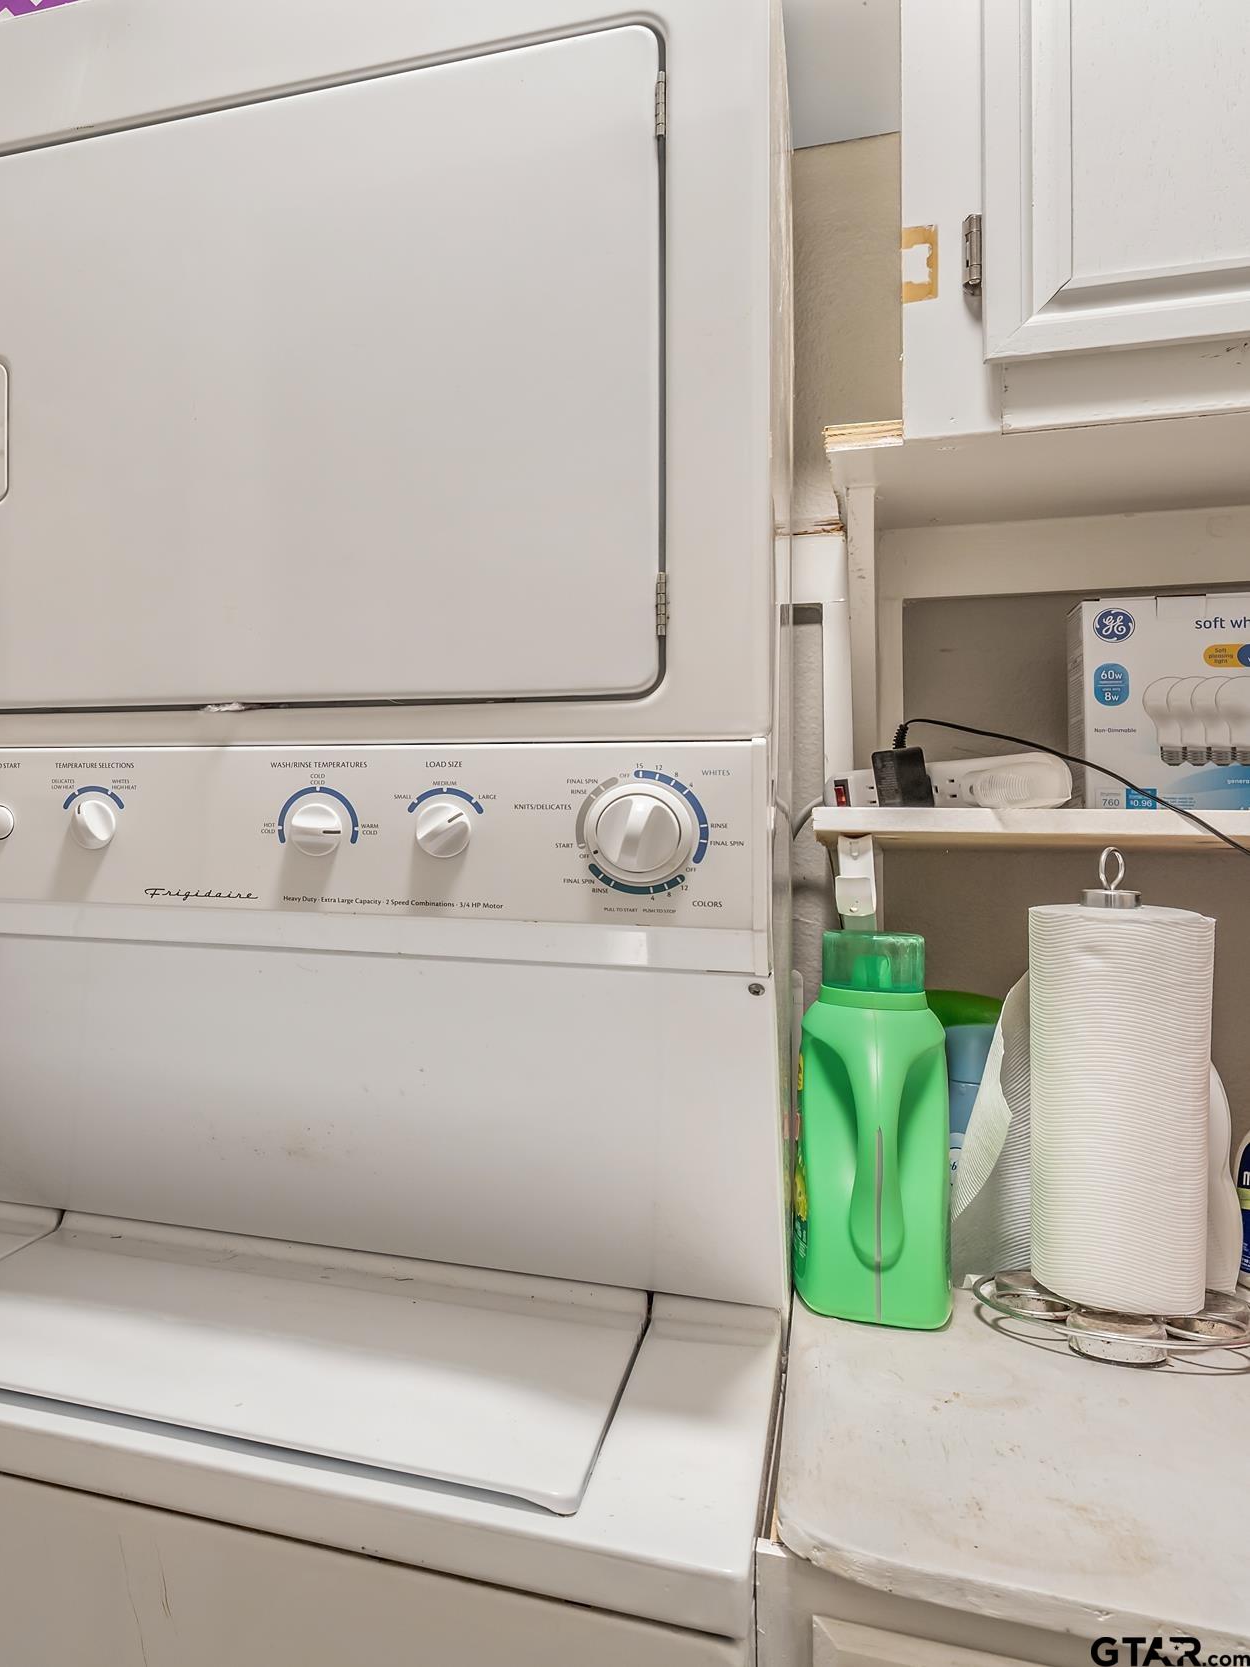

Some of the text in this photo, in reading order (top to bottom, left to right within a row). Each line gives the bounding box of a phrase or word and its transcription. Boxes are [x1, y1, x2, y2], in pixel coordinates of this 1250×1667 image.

[1195, 616, 1226, 629] soft
[1100, 670, 1123, 680] 60w
[1104, 691, 1120, 701] 8w
[702, 769, 731, 777] WHITES
[1102, 798, 1120, 807] 760
[144, 887, 259, 901] Frigidaire
[283, 895, 301, 903] Heavy
[302, 895, 317, 903] Duty
[337, 897, 353, 905] Large
[355, 898, 382, 906] Capacity
[411, 900, 455, 908] Combinations
[692, 900, 723, 908] COLORS
